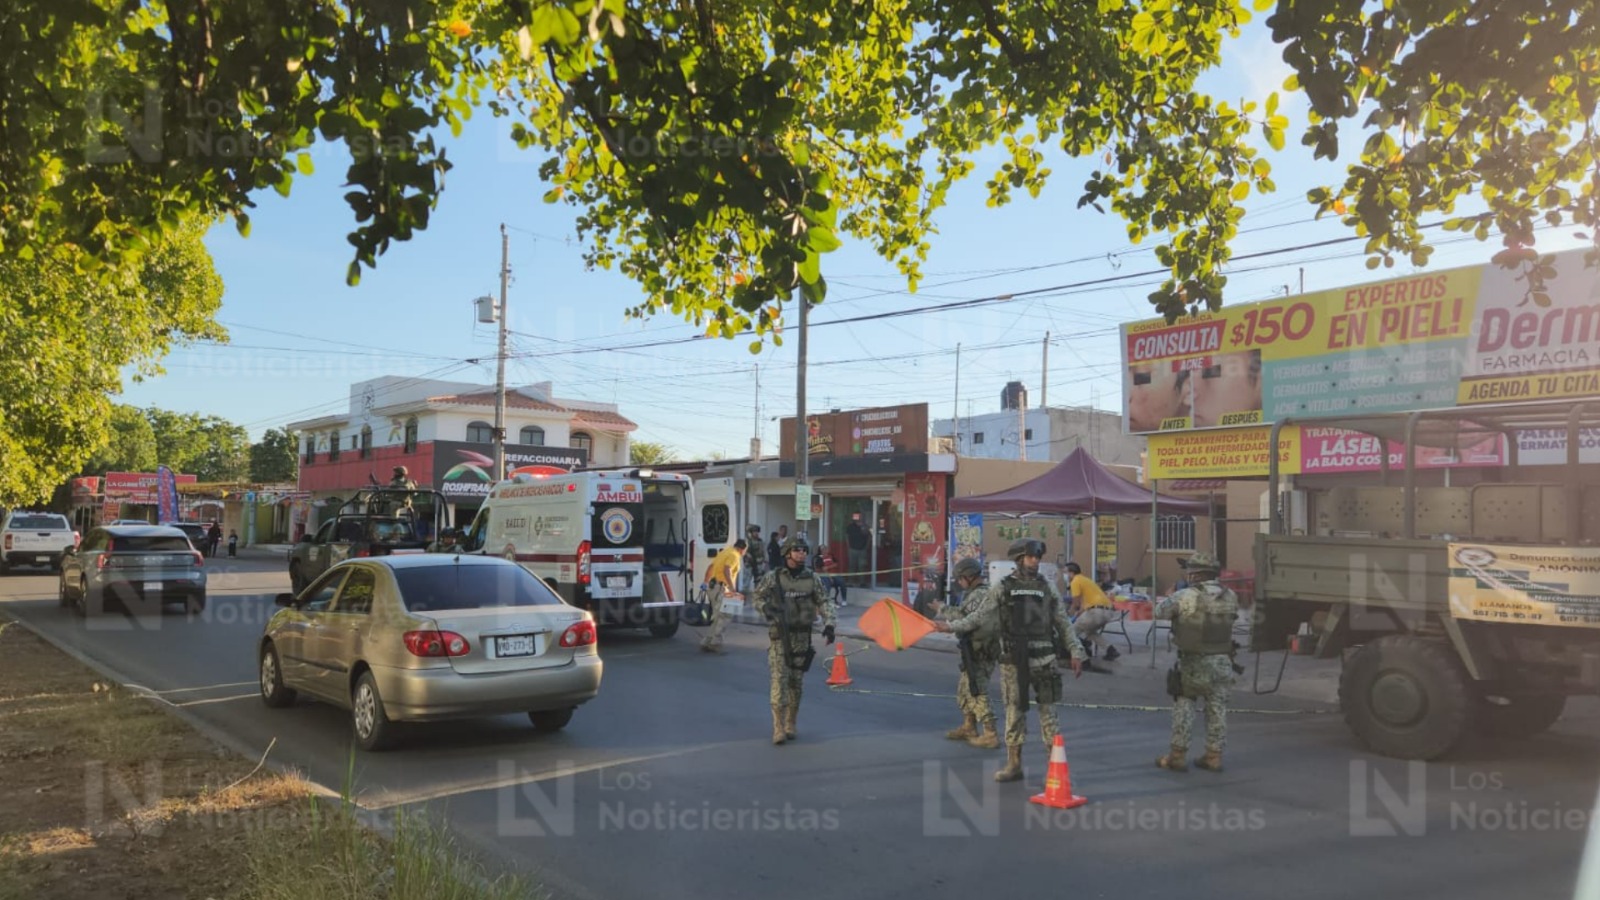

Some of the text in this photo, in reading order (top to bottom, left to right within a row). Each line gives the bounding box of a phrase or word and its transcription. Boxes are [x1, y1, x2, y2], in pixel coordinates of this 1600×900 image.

[1344, 275, 1447, 312] EXPERTOS
[1230, 302, 1315, 346] $150
[1327, 297, 1463, 349] EN PIEL!
[1134, 326, 1218, 359] CONSULTA
[1482, 349, 1590, 370] FARMACIA
[1469, 374, 1600, 400] AGENDA TU CITA
[1162, 419, 1186, 429] ANTES
[1175, 431, 1267, 446] TRATAMIENTOS PARA
[1157, 440, 1292, 457] TODAS LAS ENFERMEDADE DE
[505, 453, 581, 466] REFACCIONARIA
[1212, 453, 1241, 466] UÑAS
[1243, 455, 1250, 464] Y
[1322, 456, 1355, 467] BAJO
[1356, 454, 1403, 466] COSO!
[1509, 554, 1569, 562] Denuncia
